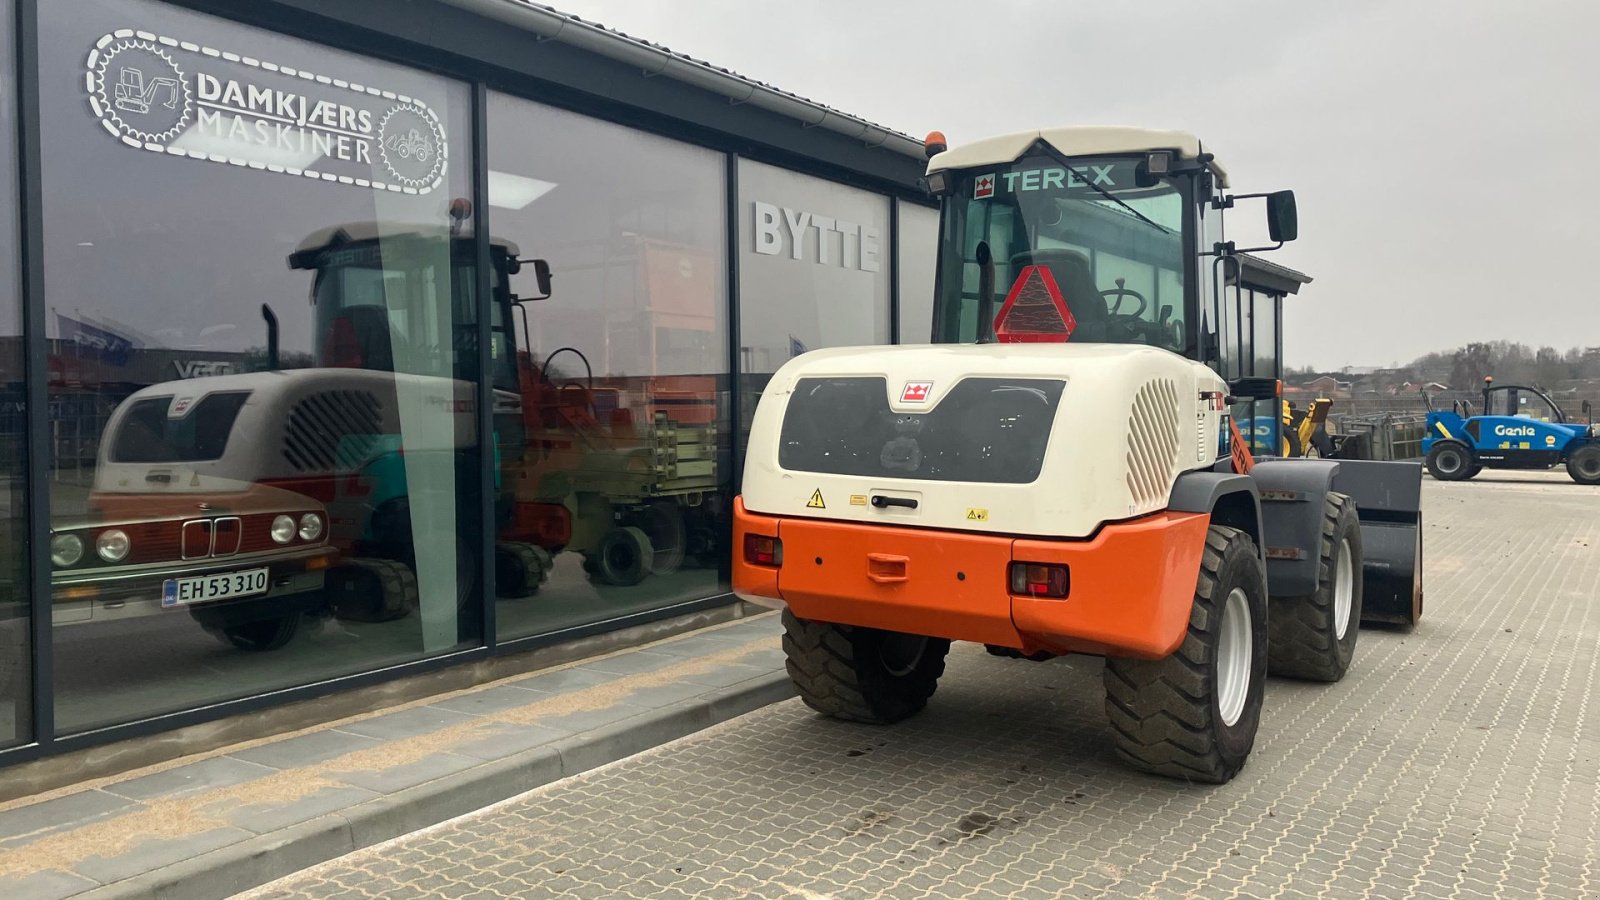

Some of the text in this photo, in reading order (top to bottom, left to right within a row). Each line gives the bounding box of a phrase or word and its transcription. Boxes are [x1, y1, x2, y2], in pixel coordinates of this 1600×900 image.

[198, 73, 372, 133] DAMKJÆRS
[198, 107, 372, 164] MASKINER
[1002, 165, 1116, 193] TEREX
[753, 200, 880, 273] BYTTE
[1494, 424, 1536, 437] Genie
[179, 572, 266, 601] EH 53 310
